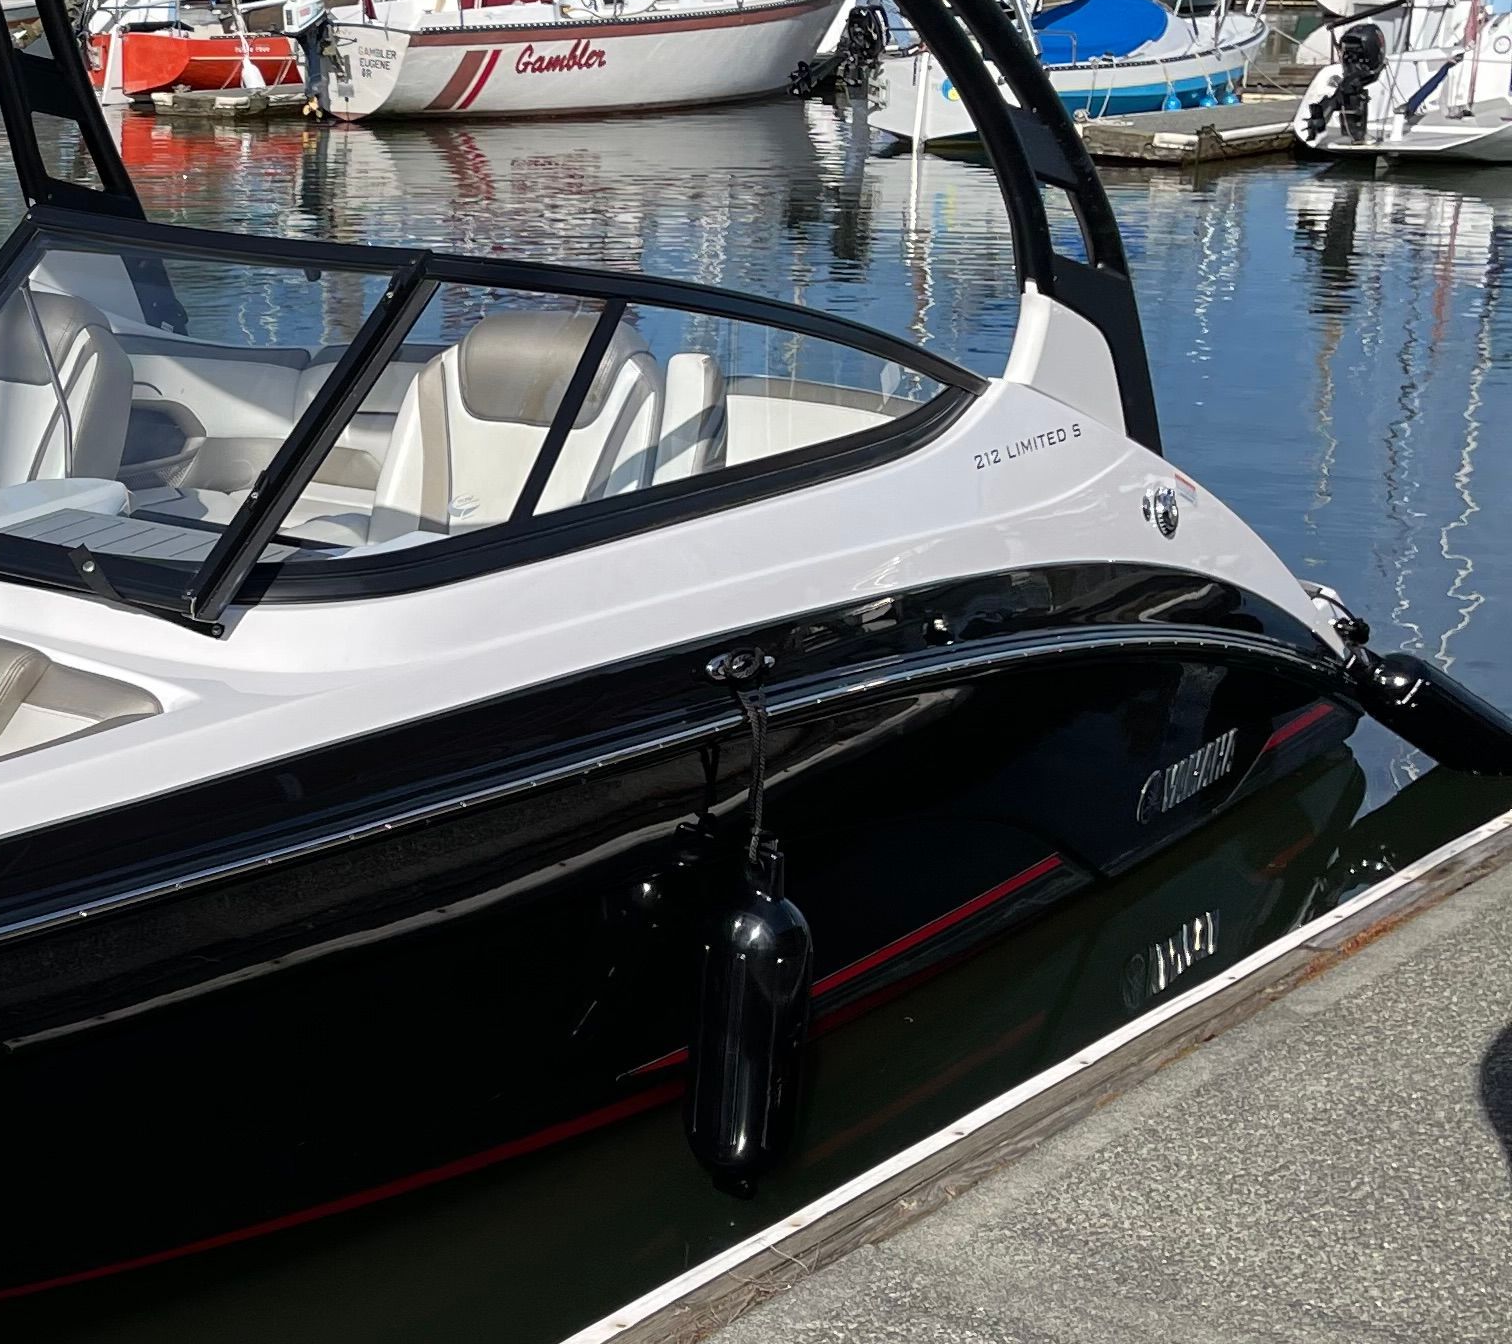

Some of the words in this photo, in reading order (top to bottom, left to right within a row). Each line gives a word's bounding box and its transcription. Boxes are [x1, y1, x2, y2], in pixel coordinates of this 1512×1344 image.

[358, 47, 397, 60] GAMBLER
[360, 58, 391, 70] EUGENE
[515, 39, 606, 74] Gambler
[974, 449, 1001, 469] 212
[1006, 428, 1067, 458] LIMITED
[1072, 423, 1081, 437] S
